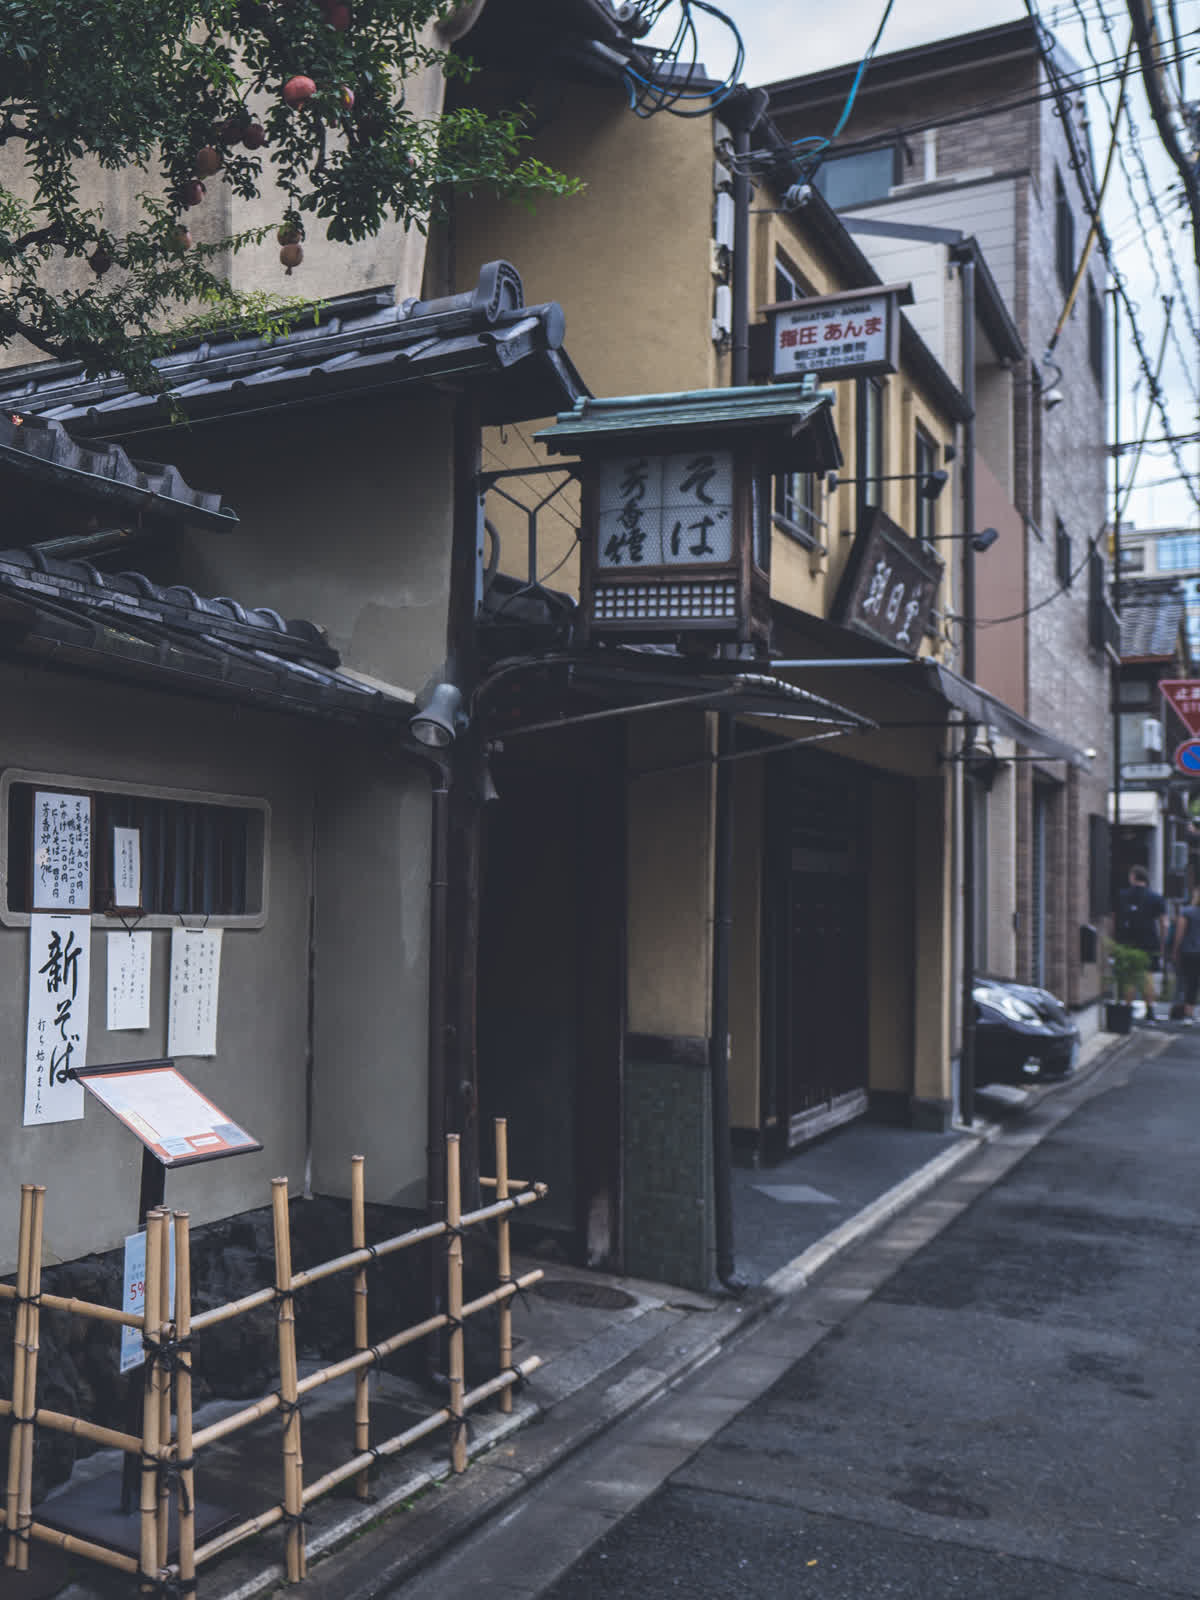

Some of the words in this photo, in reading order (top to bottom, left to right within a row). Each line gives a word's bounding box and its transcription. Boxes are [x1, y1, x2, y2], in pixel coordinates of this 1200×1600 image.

[779, 325, 818, 349] 指圧
[824, 317, 882, 341] あんま
[670, 455, 728, 556] そば
[38, 930, 82, 1087] 新そば
[35, 1018, 47, 1114] 打ち始めました
